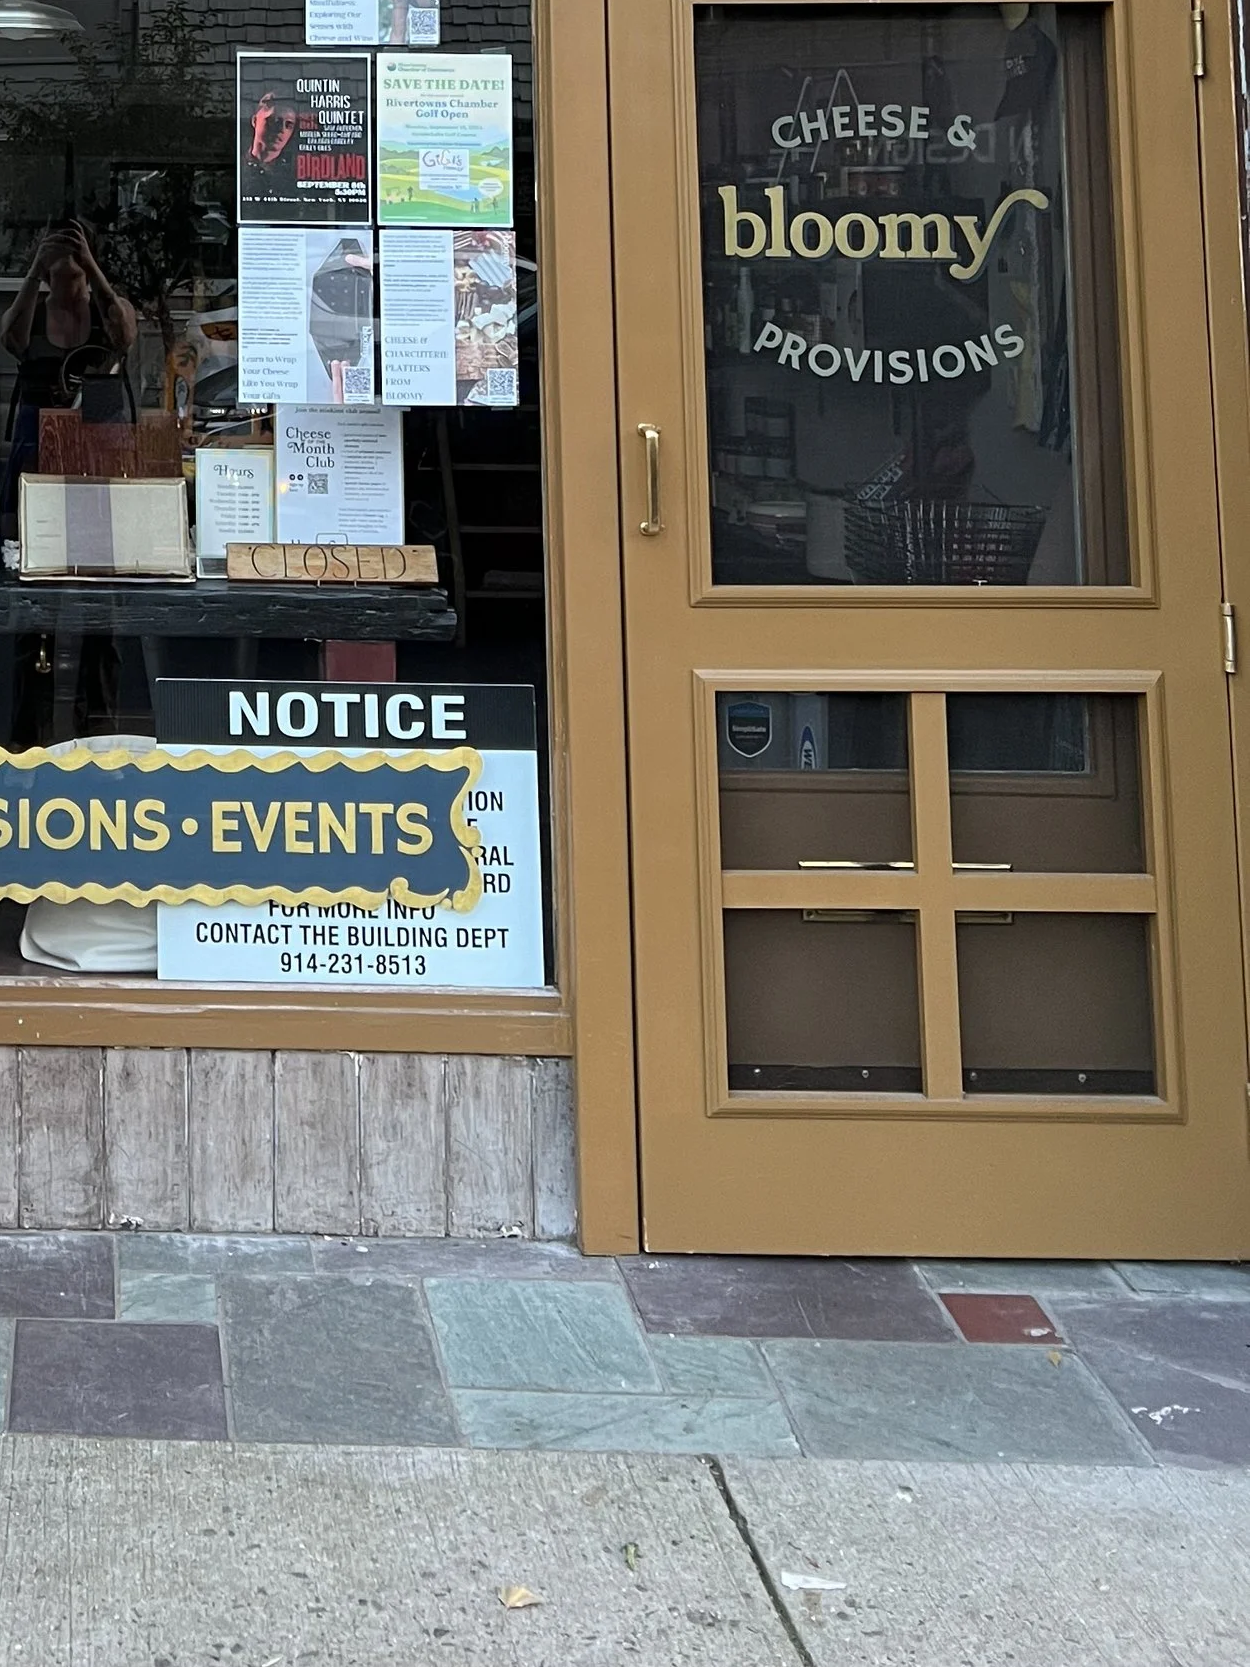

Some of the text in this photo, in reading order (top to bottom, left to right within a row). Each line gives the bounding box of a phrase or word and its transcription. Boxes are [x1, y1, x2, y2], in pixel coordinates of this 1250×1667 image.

[296, 79, 340, 92] QUINTIN
[383, 79, 505, 91] SAVE THE DATE!
[310, 95, 351, 109] HARRIS
[386, 98, 499, 108] Rivertowns Chamber
[318, 110, 365, 124] QUINTET
[415, 109, 469, 120] Golf Open
[771, 104, 930, 148] CHEESE
[947, 114, 977, 150] &
[296, 154, 366, 180] BIRDLAND
[718, 186, 1049, 280] bloomy
[384, 336, 418, 344] CHEESE
[384, 350, 449, 358] CHARCUTERIE
[753, 321, 1025, 385] PROVISIONS
[275, 356, 297, 365] Wrap
[385, 364, 431, 372] PLATTERS
[385, 392, 424, 400] BLOOMY
[285, 426, 332, 441] Cheese
[287, 442, 335, 455] Month
[306, 455, 335, 468] Club
[213, 464, 255, 479] Hours
[251, 545, 407, 580] CLOSED
[228, 690, 468, 741] NOTICE
[211, 801, 434, 855] EVENTS
[196, 922, 510, 949] CONTACT THE BUILDING DEPT
[280, 952, 427, 976] 914-231-8513
